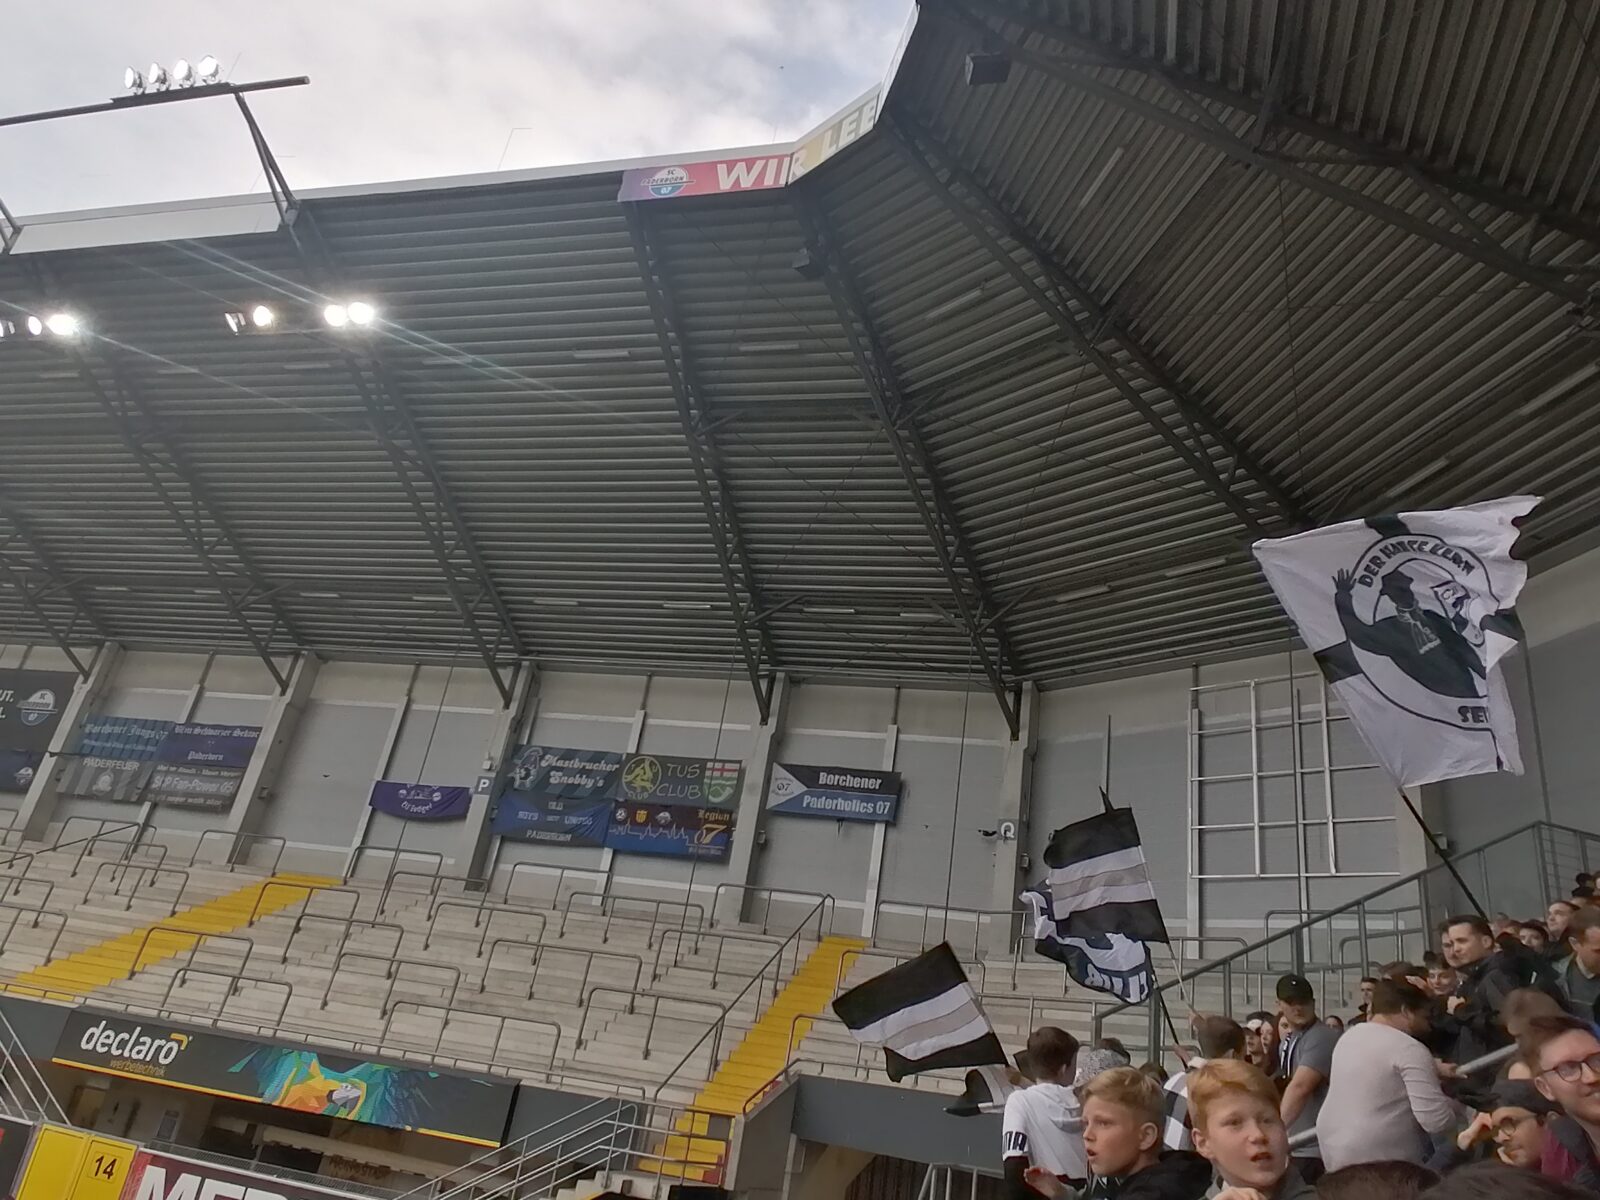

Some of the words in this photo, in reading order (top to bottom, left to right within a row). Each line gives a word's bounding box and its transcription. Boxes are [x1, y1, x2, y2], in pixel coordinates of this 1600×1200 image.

[717, 149, 808, 191] WIR
[1357, 555, 1386, 588] DER
[1457, 705, 1489, 724] SE
[540, 753, 620, 772] Mastbrucher
[666, 763, 701, 779] TUS
[477, 778, 490, 792] P
[818, 771, 882, 790] Borchener
[656, 783, 702, 800] CLUB
[802, 794, 875, 814] Paderholics
[875, 801, 891, 815] 07
[1000, 821, 1015, 838] Q
[80, 1020, 180, 1065] declaro
[94, 1155, 115, 1180] 14
